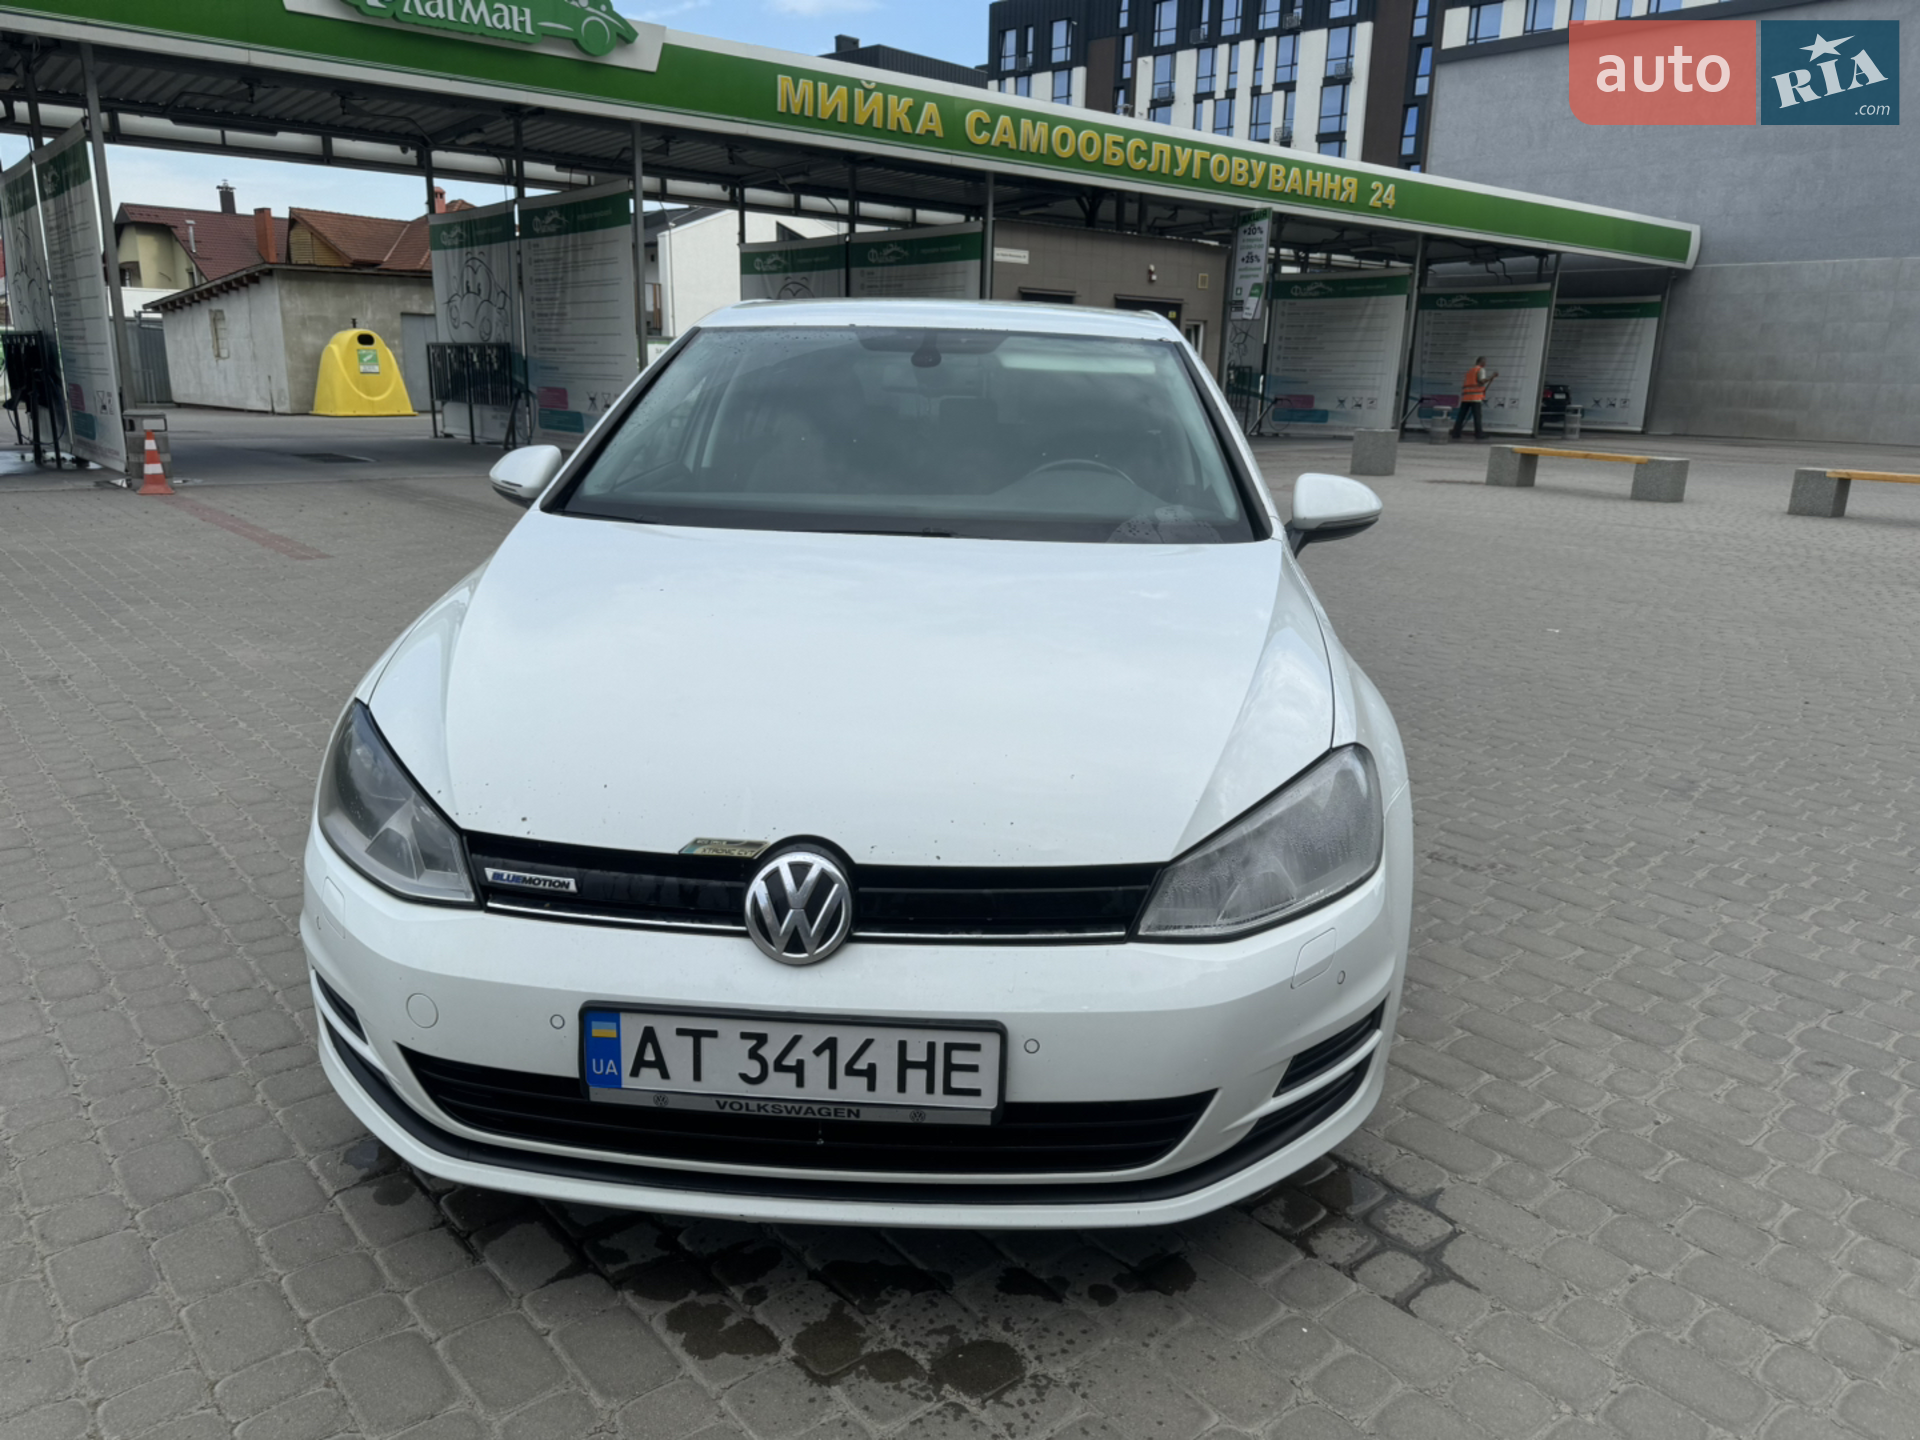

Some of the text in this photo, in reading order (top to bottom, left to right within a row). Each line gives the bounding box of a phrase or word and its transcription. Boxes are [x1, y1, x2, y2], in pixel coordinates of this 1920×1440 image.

[366, 0, 536, 35] лагман
[777, 74, 1396, 209] МИЙКА САМООБСЛУГОВУВАННЯ 24
[1243, 226, 1263, 236] +20%
[1241, 254, 1260, 264] +25%
[492, 871, 571, 889] BLUEMOTION
[592, 1058, 618, 1075] UA
[629, 1025, 982, 1097] AT 3414 HE
[715, 1100, 860, 1119] VOLKSWAGEN
